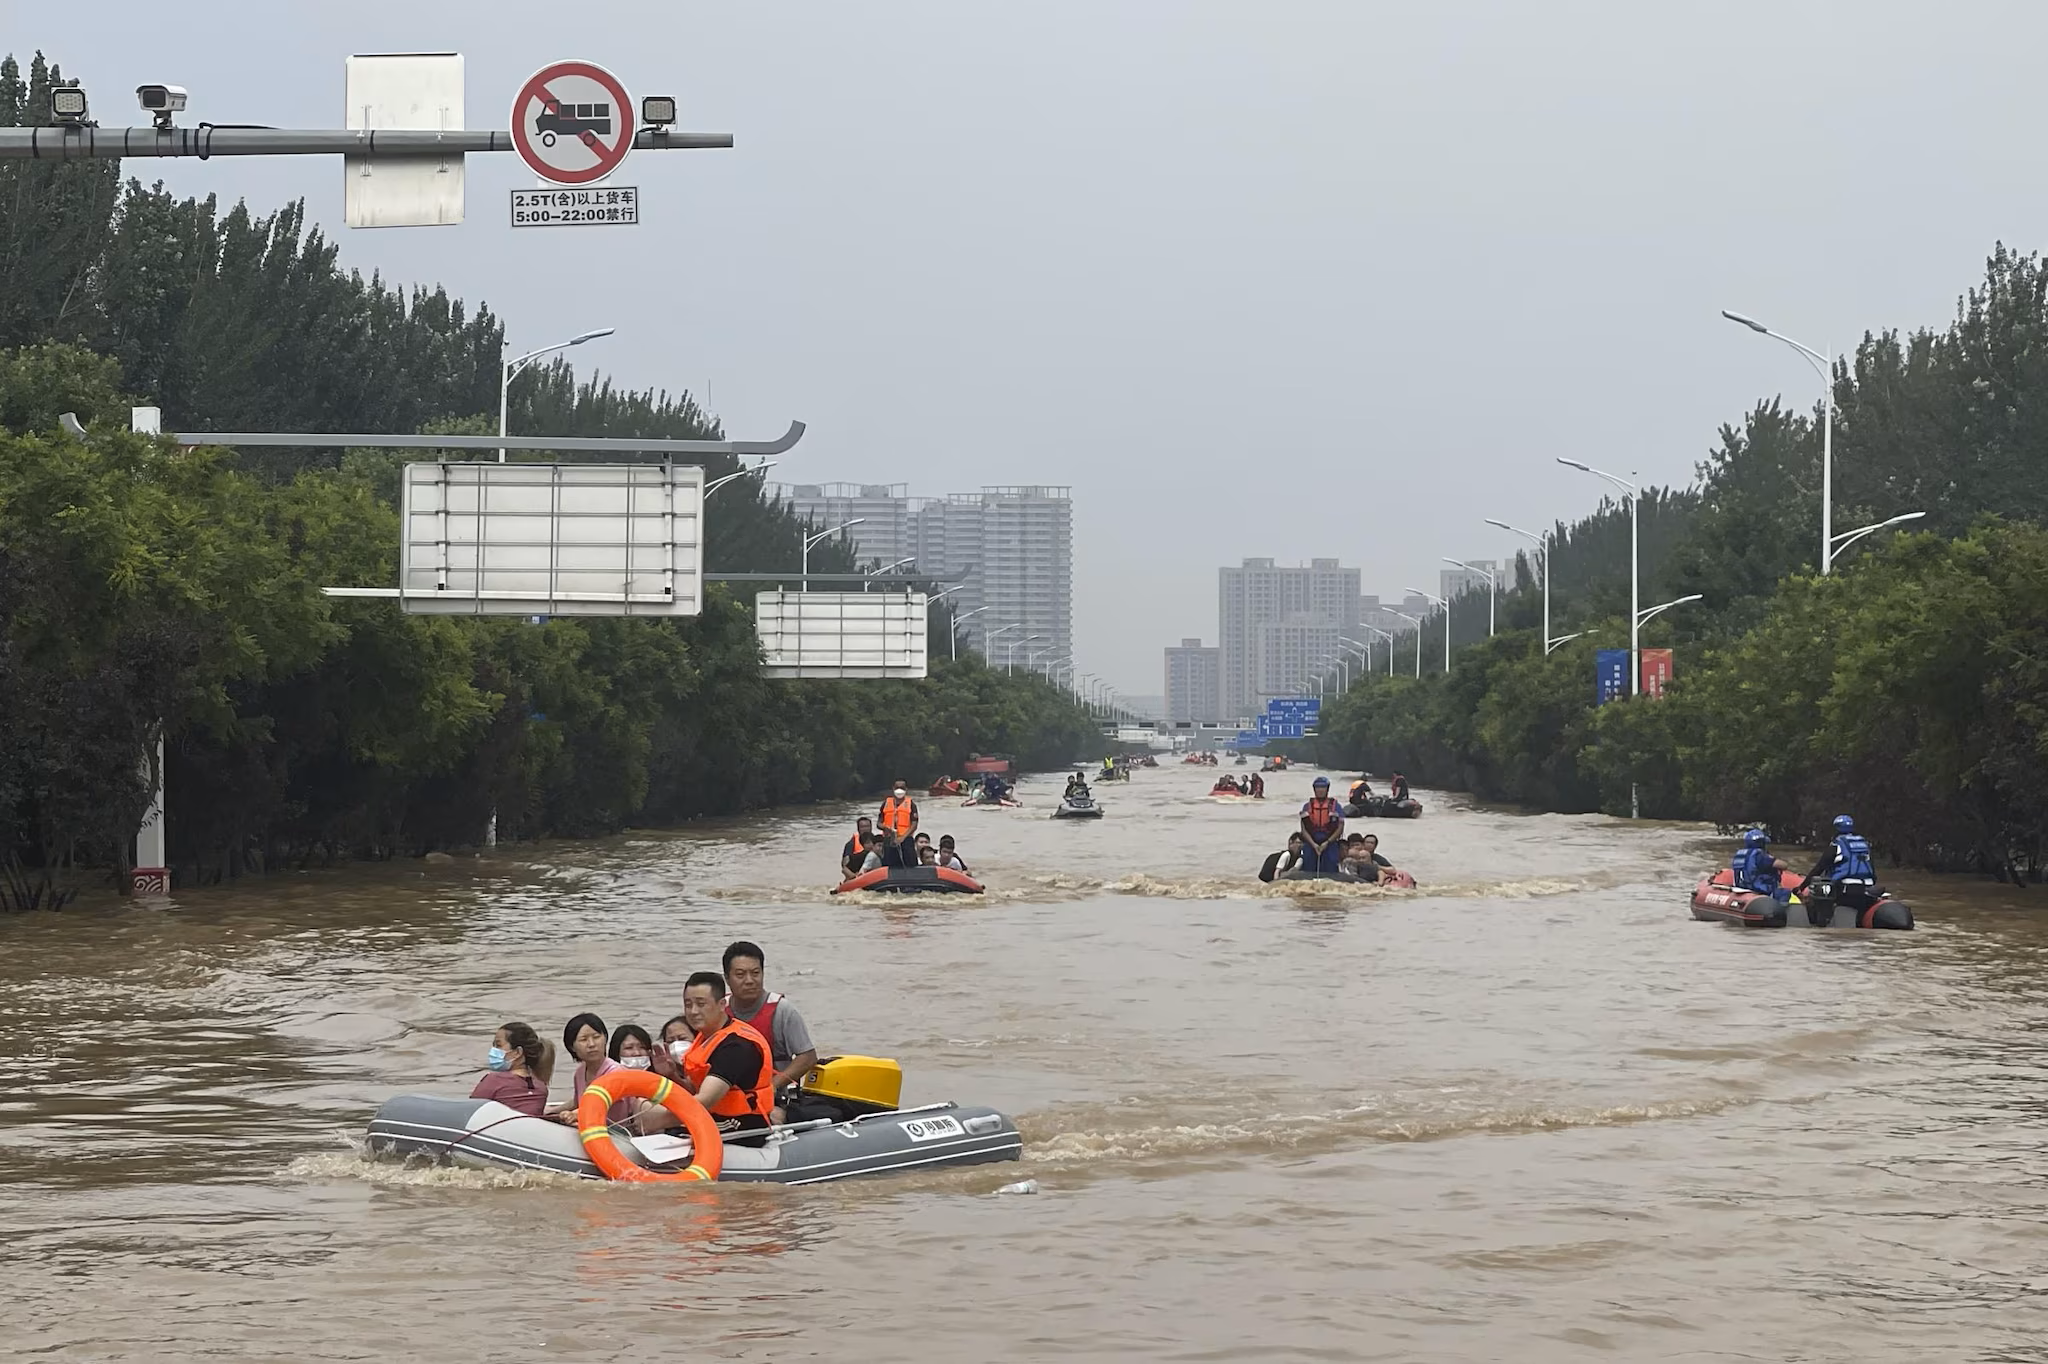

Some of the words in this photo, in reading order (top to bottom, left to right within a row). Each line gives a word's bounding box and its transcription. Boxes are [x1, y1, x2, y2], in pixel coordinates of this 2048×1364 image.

[515, 191, 634, 207] 2.5T(含)以上货车
